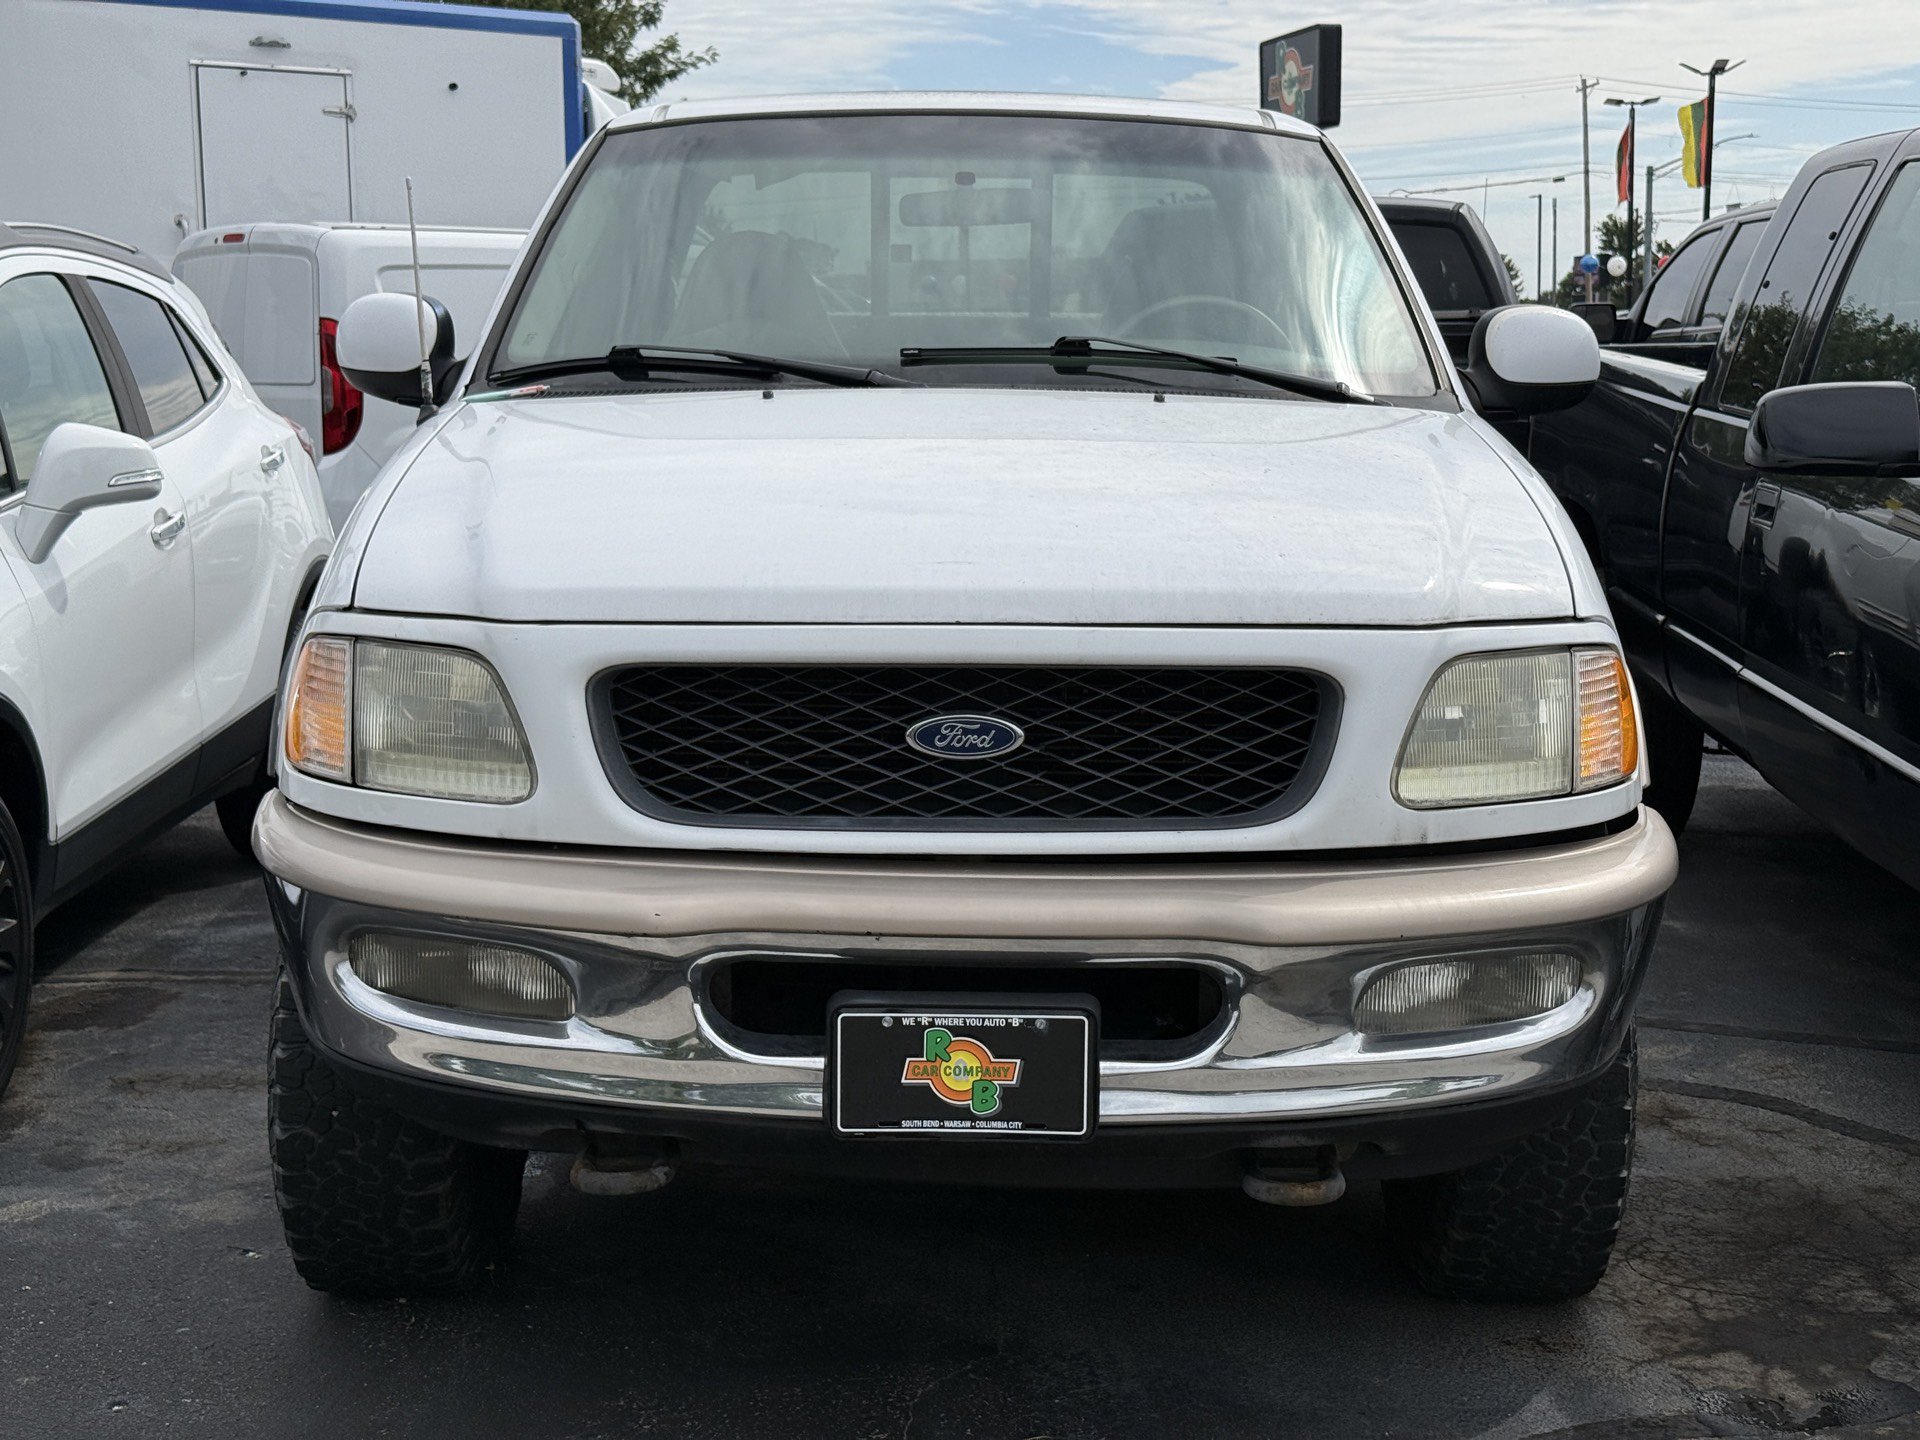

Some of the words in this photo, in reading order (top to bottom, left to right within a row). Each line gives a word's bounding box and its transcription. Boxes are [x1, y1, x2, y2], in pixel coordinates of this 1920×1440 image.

[934, 722, 996, 748] Ford
[901, 1017, 916, 1026] WE
[917, 1016, 933, 1026] "R"
[934, 1017, 965, 1026] WHERE
[965, 1018, 983, 1027] YOU
[983, 1018, 1006, 1027] AUTO
[1007, 1017, 1024, 1027] "B"
[925, 1028, 952, 1063] R
[911, 1064, 939, 1077] CAR
[943, 1064, 1011, 1078] COMPANY
[971, 1079, 998, 1113] B
[901, 1120, 922, 1128] SOUTH
[922, 1120, 940, 1128] BEND
[943, 1120, 972, 1128] WARSAW
[975, 1120, 1008, 1129] COLUMBIA
[1008, 1121, 1023, 1129] CITY
